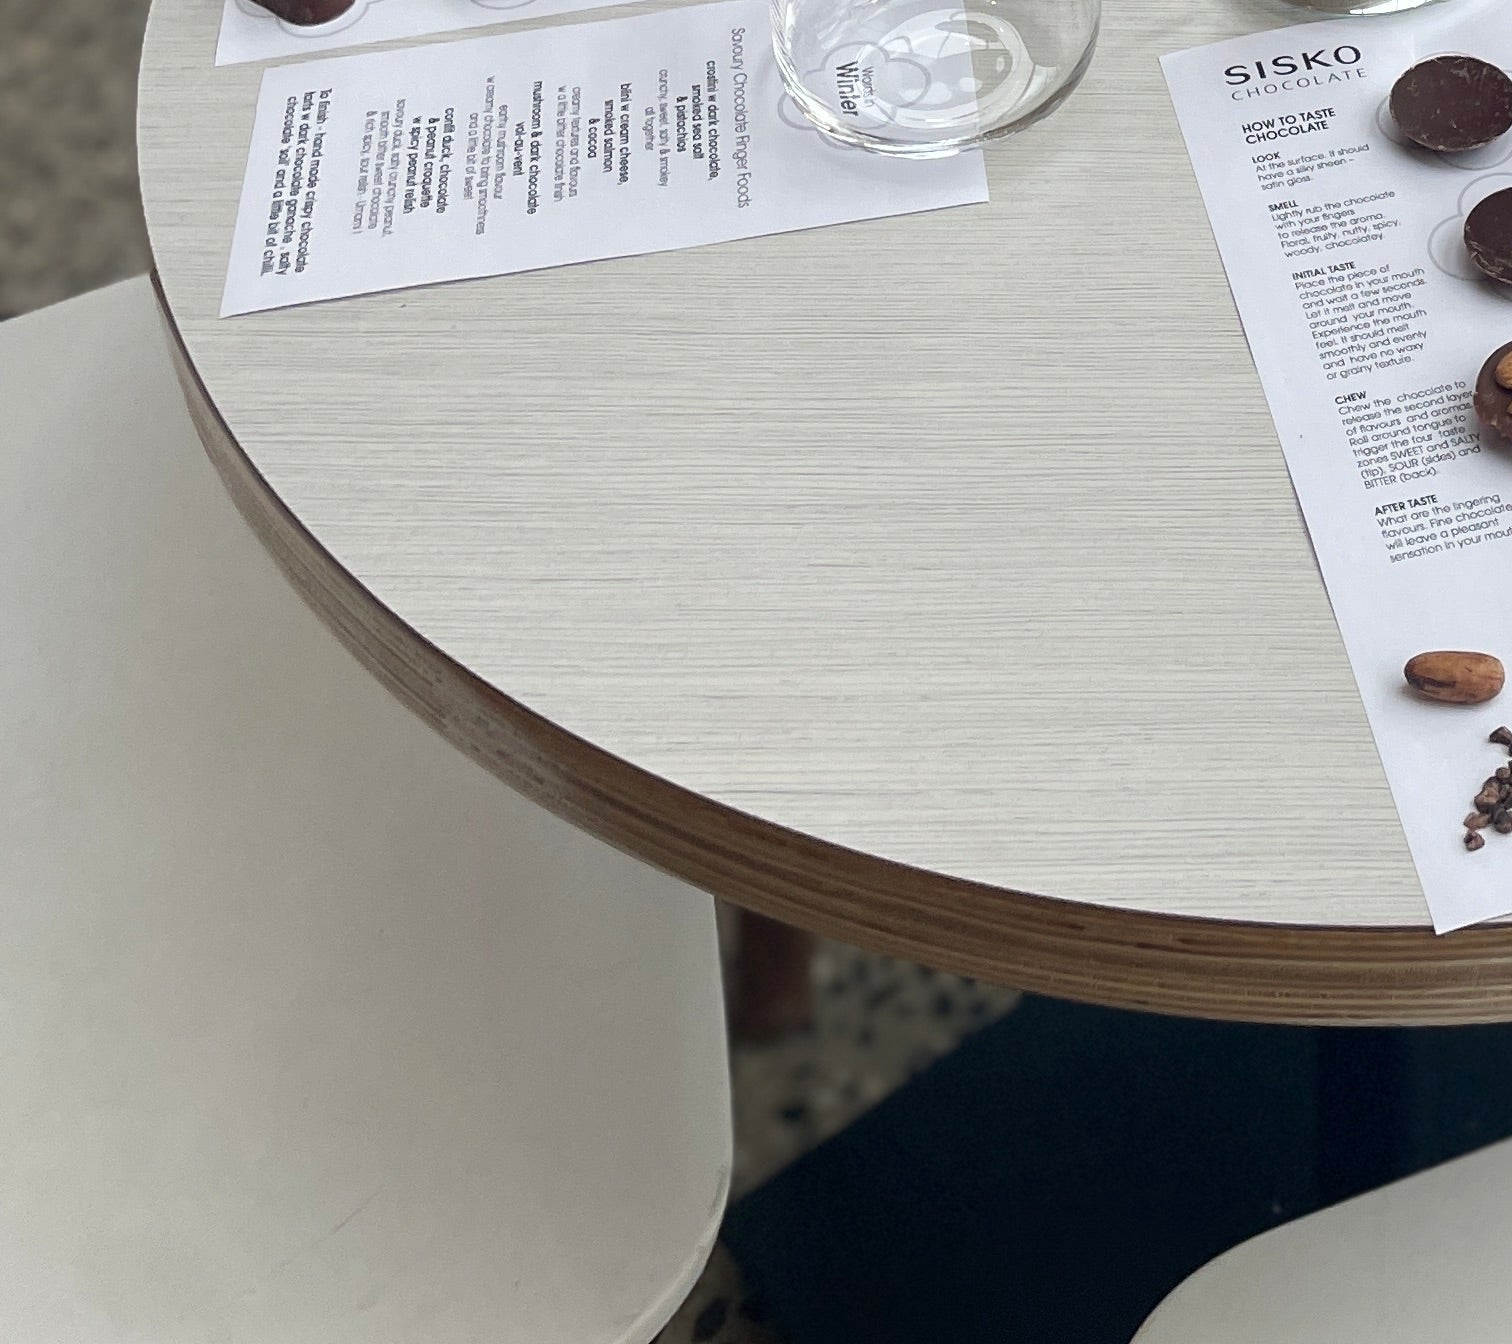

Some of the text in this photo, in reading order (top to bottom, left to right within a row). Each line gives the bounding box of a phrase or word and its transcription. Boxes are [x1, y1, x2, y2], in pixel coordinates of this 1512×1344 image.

[1224, 45, 1361, 86] SISKO
[835, 60, 861, 117] Winter
[1231, 67, 1367, 101] CHOCOLATE
[730, 27, 753, 209] Savoury Chocolate Finger Foods
[1241, 107, 1337, 134] HOW TO TASTE
[1245, 119, 1330, 145] CHOCOLATE
[1251, 151, 1281, 164] LOOK
[1267, 199, 1299, 213] SMELL
[1291, 260, 1357, 281] INITIAL TASTE
[1334, 390, 1367, 405] CHEW
[1374, 494, 1439, 517] AFTER TASTE
[1376, 494, 1502, 528] What are the lingering
[1385, 517, 1500, 551] will leave a pleasant
[1428, 516, 1453, 529] Fine
